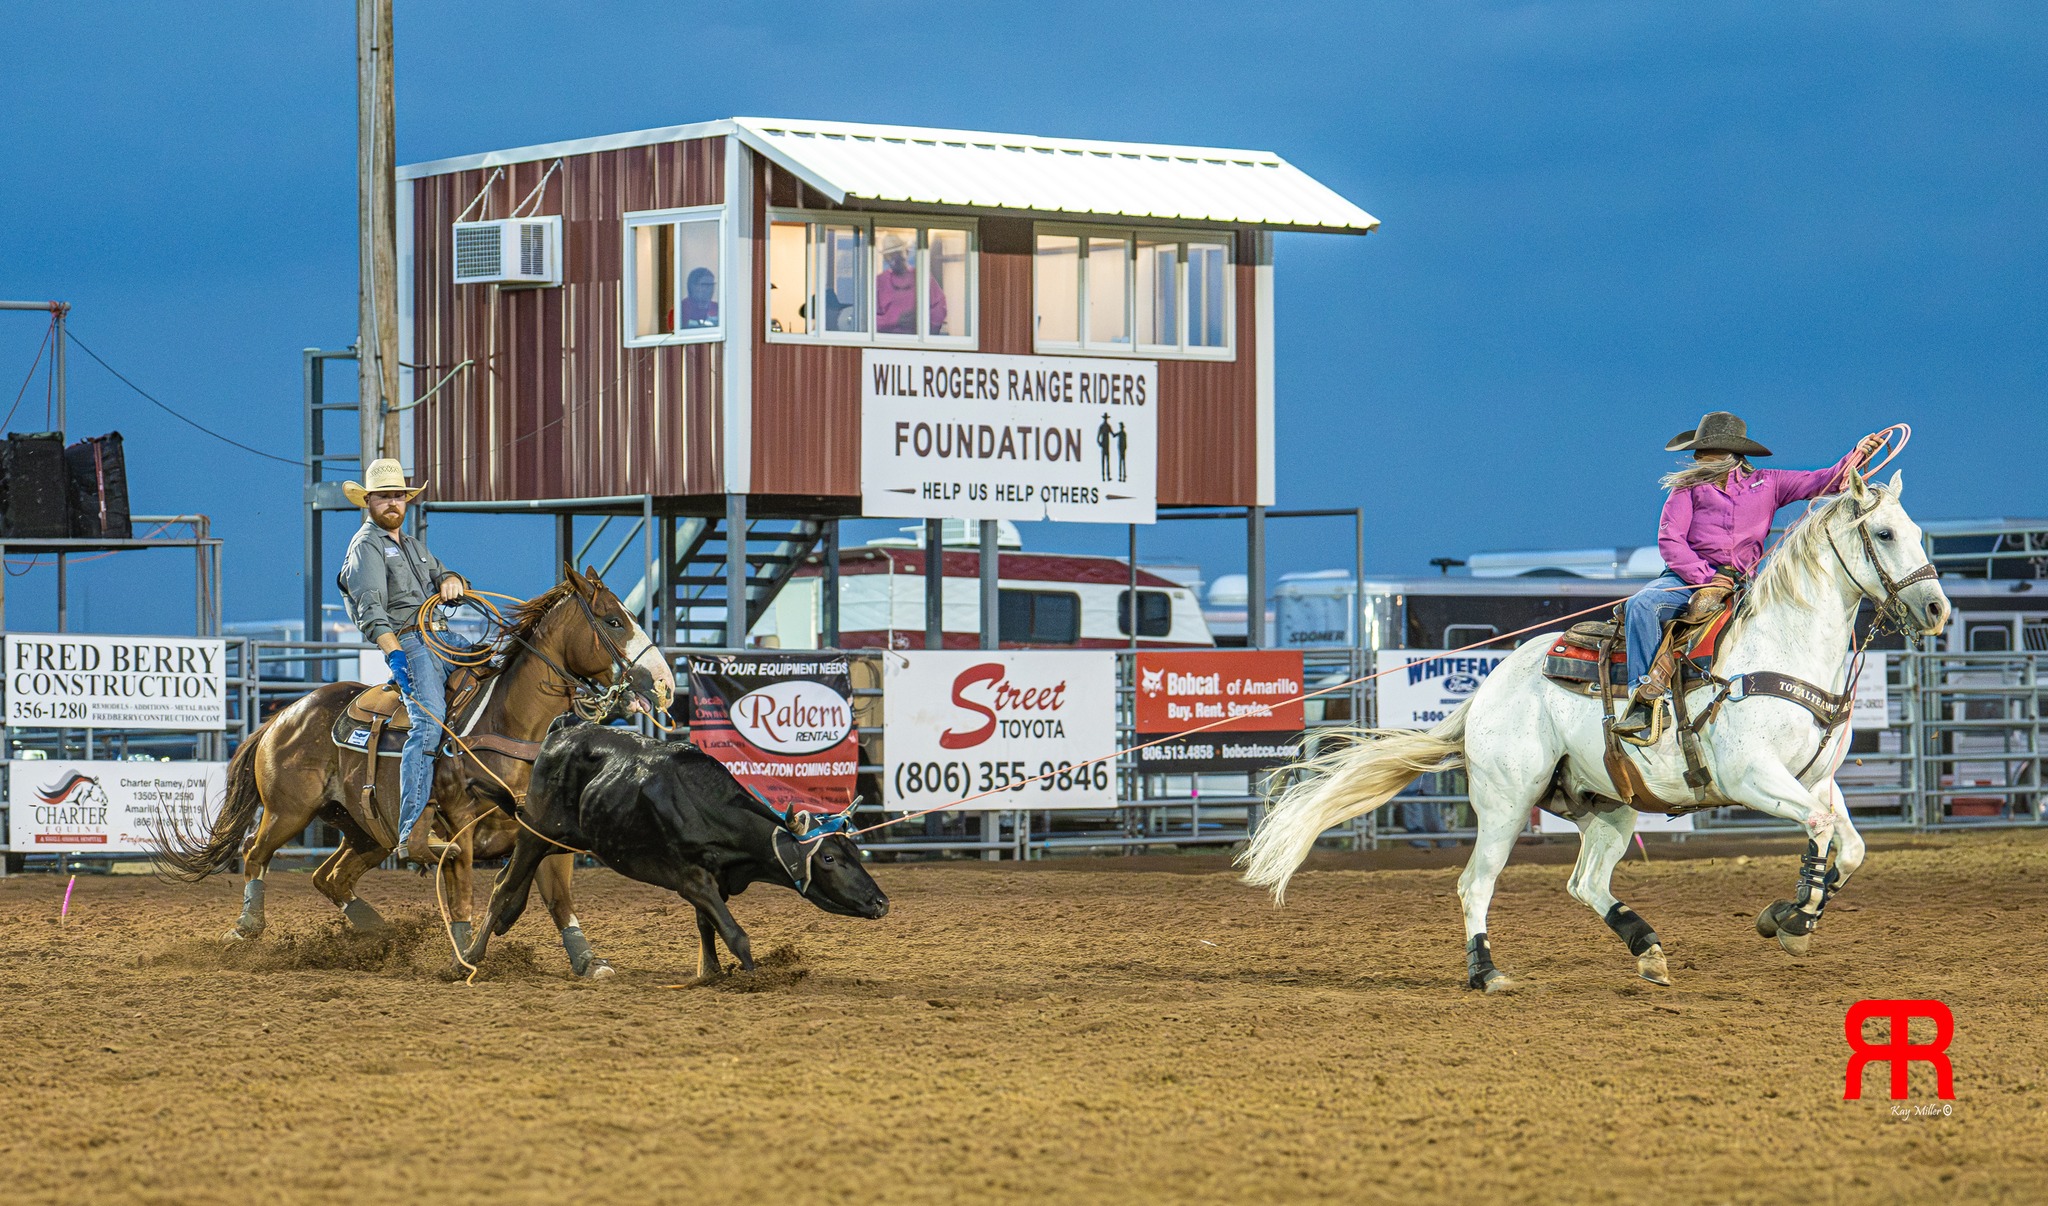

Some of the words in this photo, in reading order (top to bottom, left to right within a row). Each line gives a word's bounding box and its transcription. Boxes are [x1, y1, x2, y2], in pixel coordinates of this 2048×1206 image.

[873, 363, 917, 397] WILL
[923, 365, 1000, 400] ROGERS
[1008, 369, 1073, 403] RANGE
[1080, 372, 1146, 406] RIDERS
[895, 421, 1082, 462] FOUNDATION
[923, 482, 961, 500] HELP
[968, 483, 988, 501] US
[996, 484, 1034, 502] HELP
[1041, 485, 1099, 504] OTHERS
[15, 642, 100, 671] FRED
[111, 644, 218, 674] BERRY
[692, 662, 717, 675] ALL
[720, 662, 757, 676] YOUR
[758, 662, 818, 676] EQUIPMENT
[819, 662, 849, 675] NEEDS
[14, 672, 218, 698] CONSTRUCTION
[1167, 672, 1220, 696] Bobcat
[1226, 678, 1242, 695] of
[1243, 678, 1299, 695] Amarillo
[13, 701, 87, 719] 356-1280
[939, 662, 1067, 749] Street
[1167, 702, 1193, 721] Buy.
[1195, 702, 1226, 718] Rent.
[1227, 701, 1273, 718] Service.
[739, 694, 846, 743] Rabern
[999, 718, 1066, 739] TOYOTA
[795, 730, 839, 742] RENTALS
[722, 761, 749, 775] OCK
[795, 762, 831, 777] COMING
[832, 761, 857, 776] SOON
[894, 761, 971, 798] (806)
[979, 760, 1108, 792] 355-9846
[120, 778, 152, 788] Charter
[35, 805, 108, 825] CHARTER
